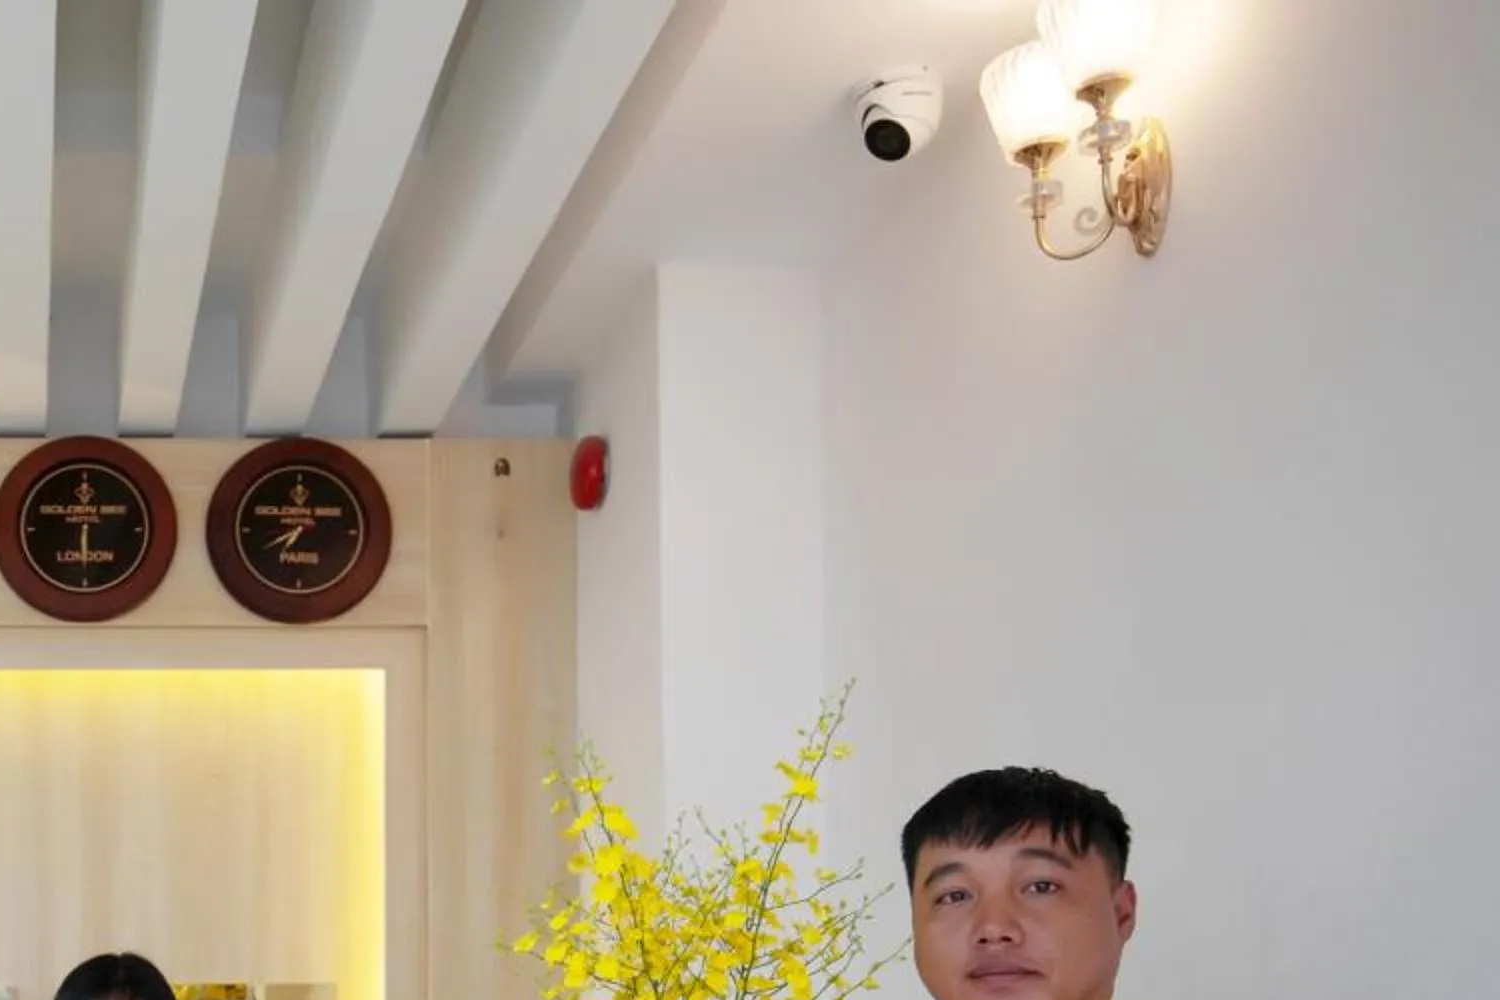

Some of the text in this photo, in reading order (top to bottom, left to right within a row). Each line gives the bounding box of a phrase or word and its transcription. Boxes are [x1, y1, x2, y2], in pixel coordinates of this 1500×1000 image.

[40, 505, 98, 514] GOLDEN
[254, 506, 313, 515] GOLDEN
[57, 550, 113, 562] LONDON
[279, 551, 318, 564] PARIS
